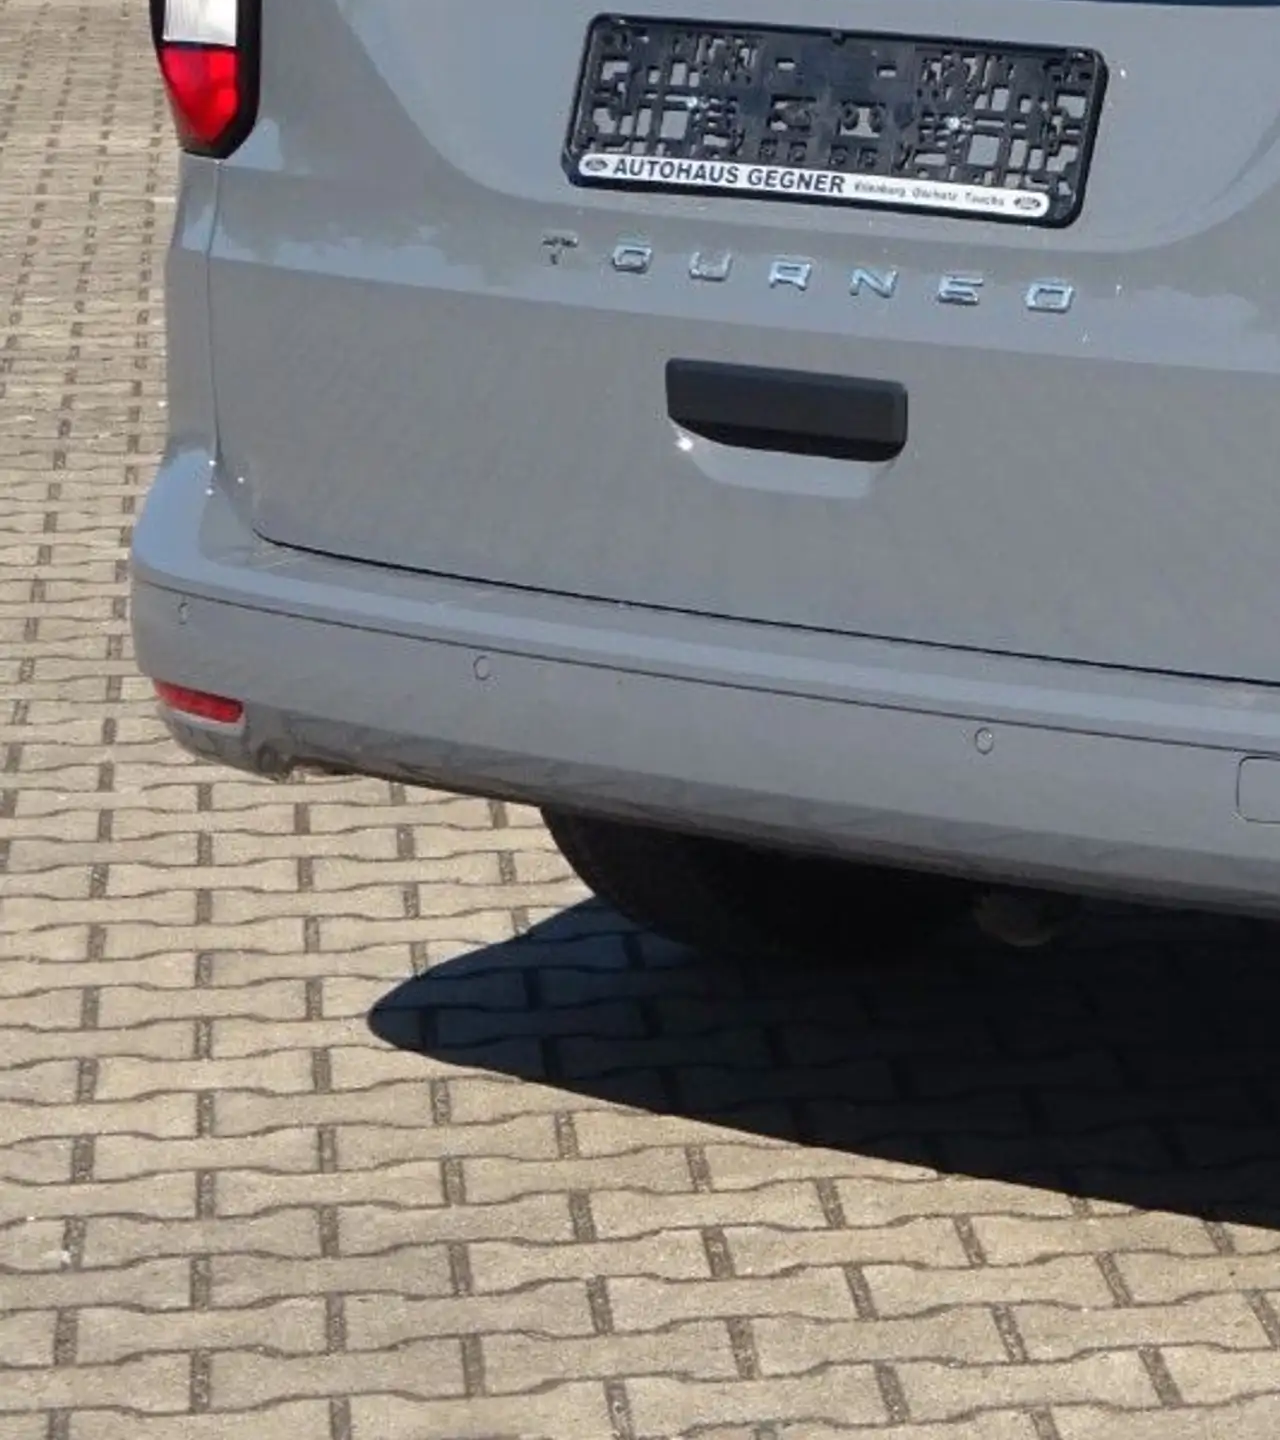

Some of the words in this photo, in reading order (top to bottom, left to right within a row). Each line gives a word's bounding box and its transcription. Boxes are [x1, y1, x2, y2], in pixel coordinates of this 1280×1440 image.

[612, 158, 740, 184] AUTOHAUS
[746, 167, 846, 194] GEGNER
[541, 234, 1076, 314] TOURNEO
